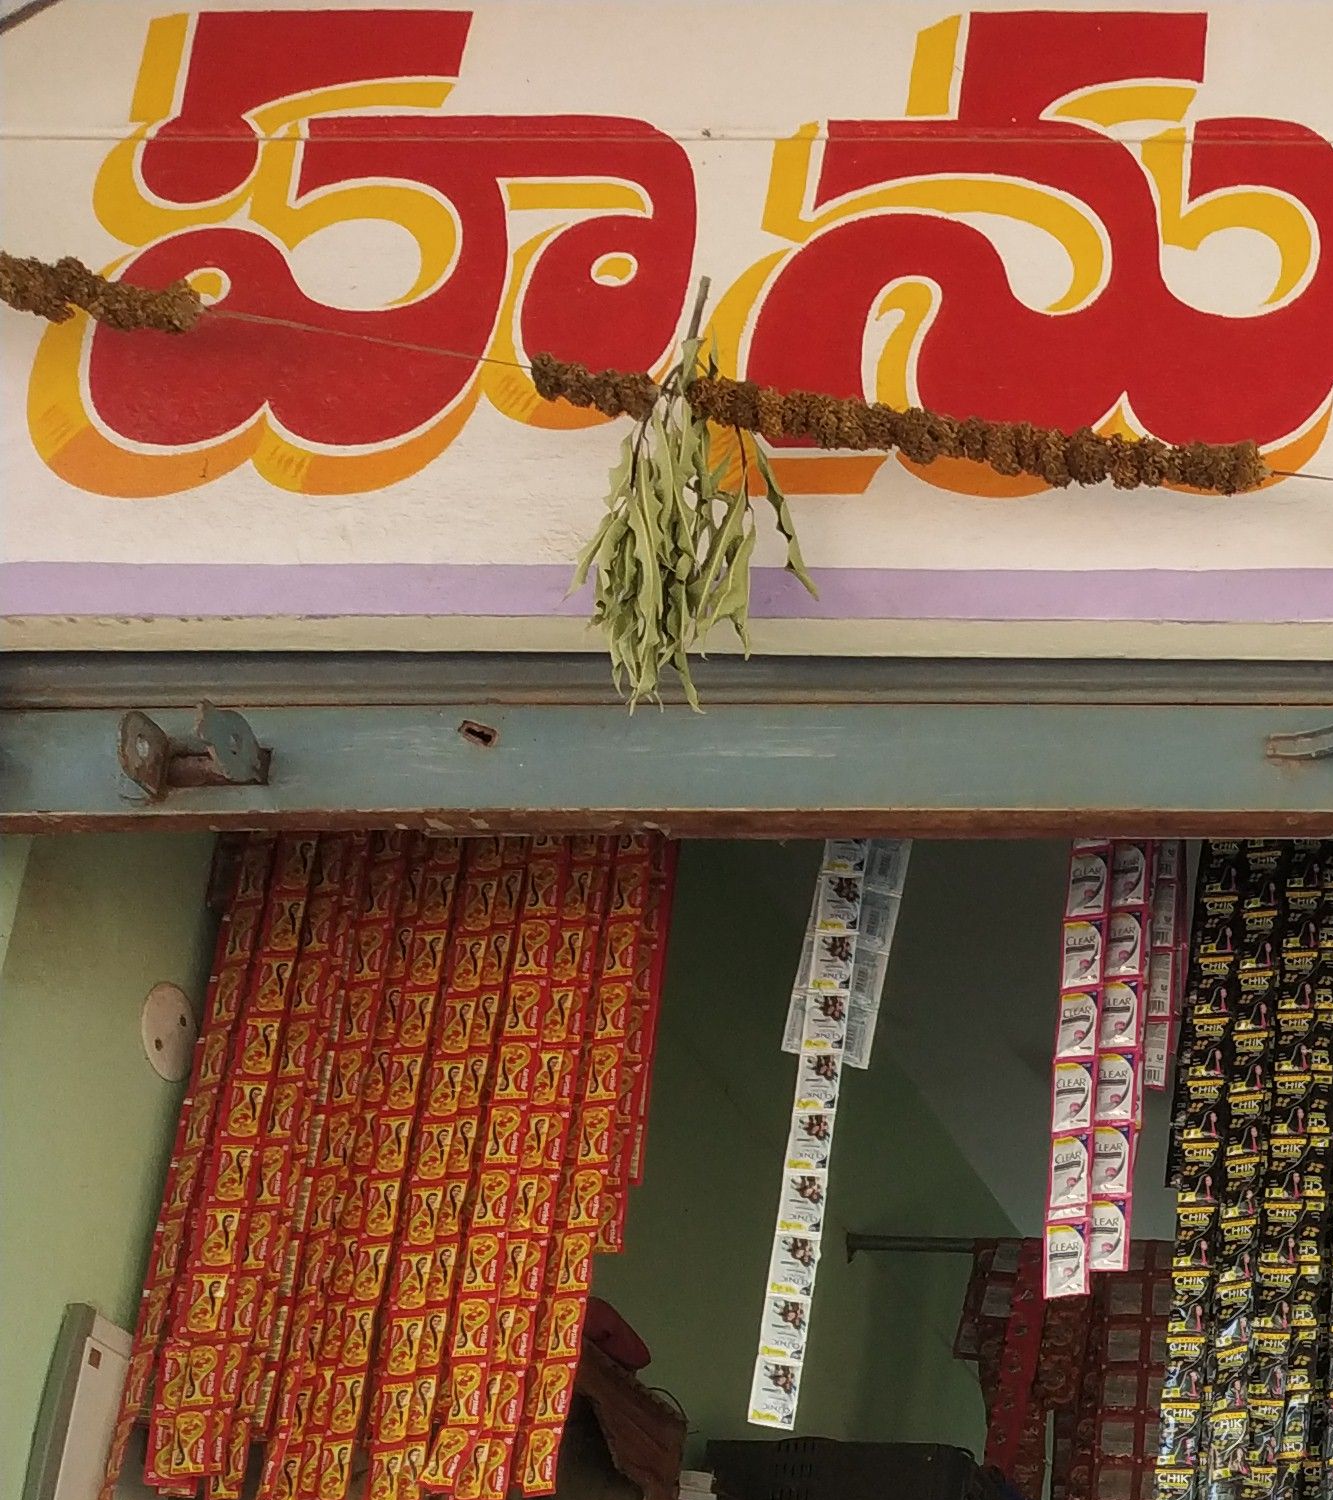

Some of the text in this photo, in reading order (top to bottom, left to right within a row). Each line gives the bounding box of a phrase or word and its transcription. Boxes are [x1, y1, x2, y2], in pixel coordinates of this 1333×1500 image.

[1065, 933, 1097, 947] CLEAR
[1062, 1005, 1093, 1019] CLEAR
[1056, 1077, 1087, 1089] CLEAR
[1054, 1149, 1083, 1165] CLEAR
[1180, 1212, 1210, 1225] CHIK
[1267, 1208, 1297, 1221] CHIK
[1224, 1225, 1252, 1238] CHIK
[1050, 1241, 1080, 1252] CLEAR
[1174, 1276, 1205, 1290] CHIK
[1169, 1341, 1200, 1354] CHIK
[1164, 1406, 1195, 1420] CHIK
[1157, 1472, 1189, 1486] CHIK
